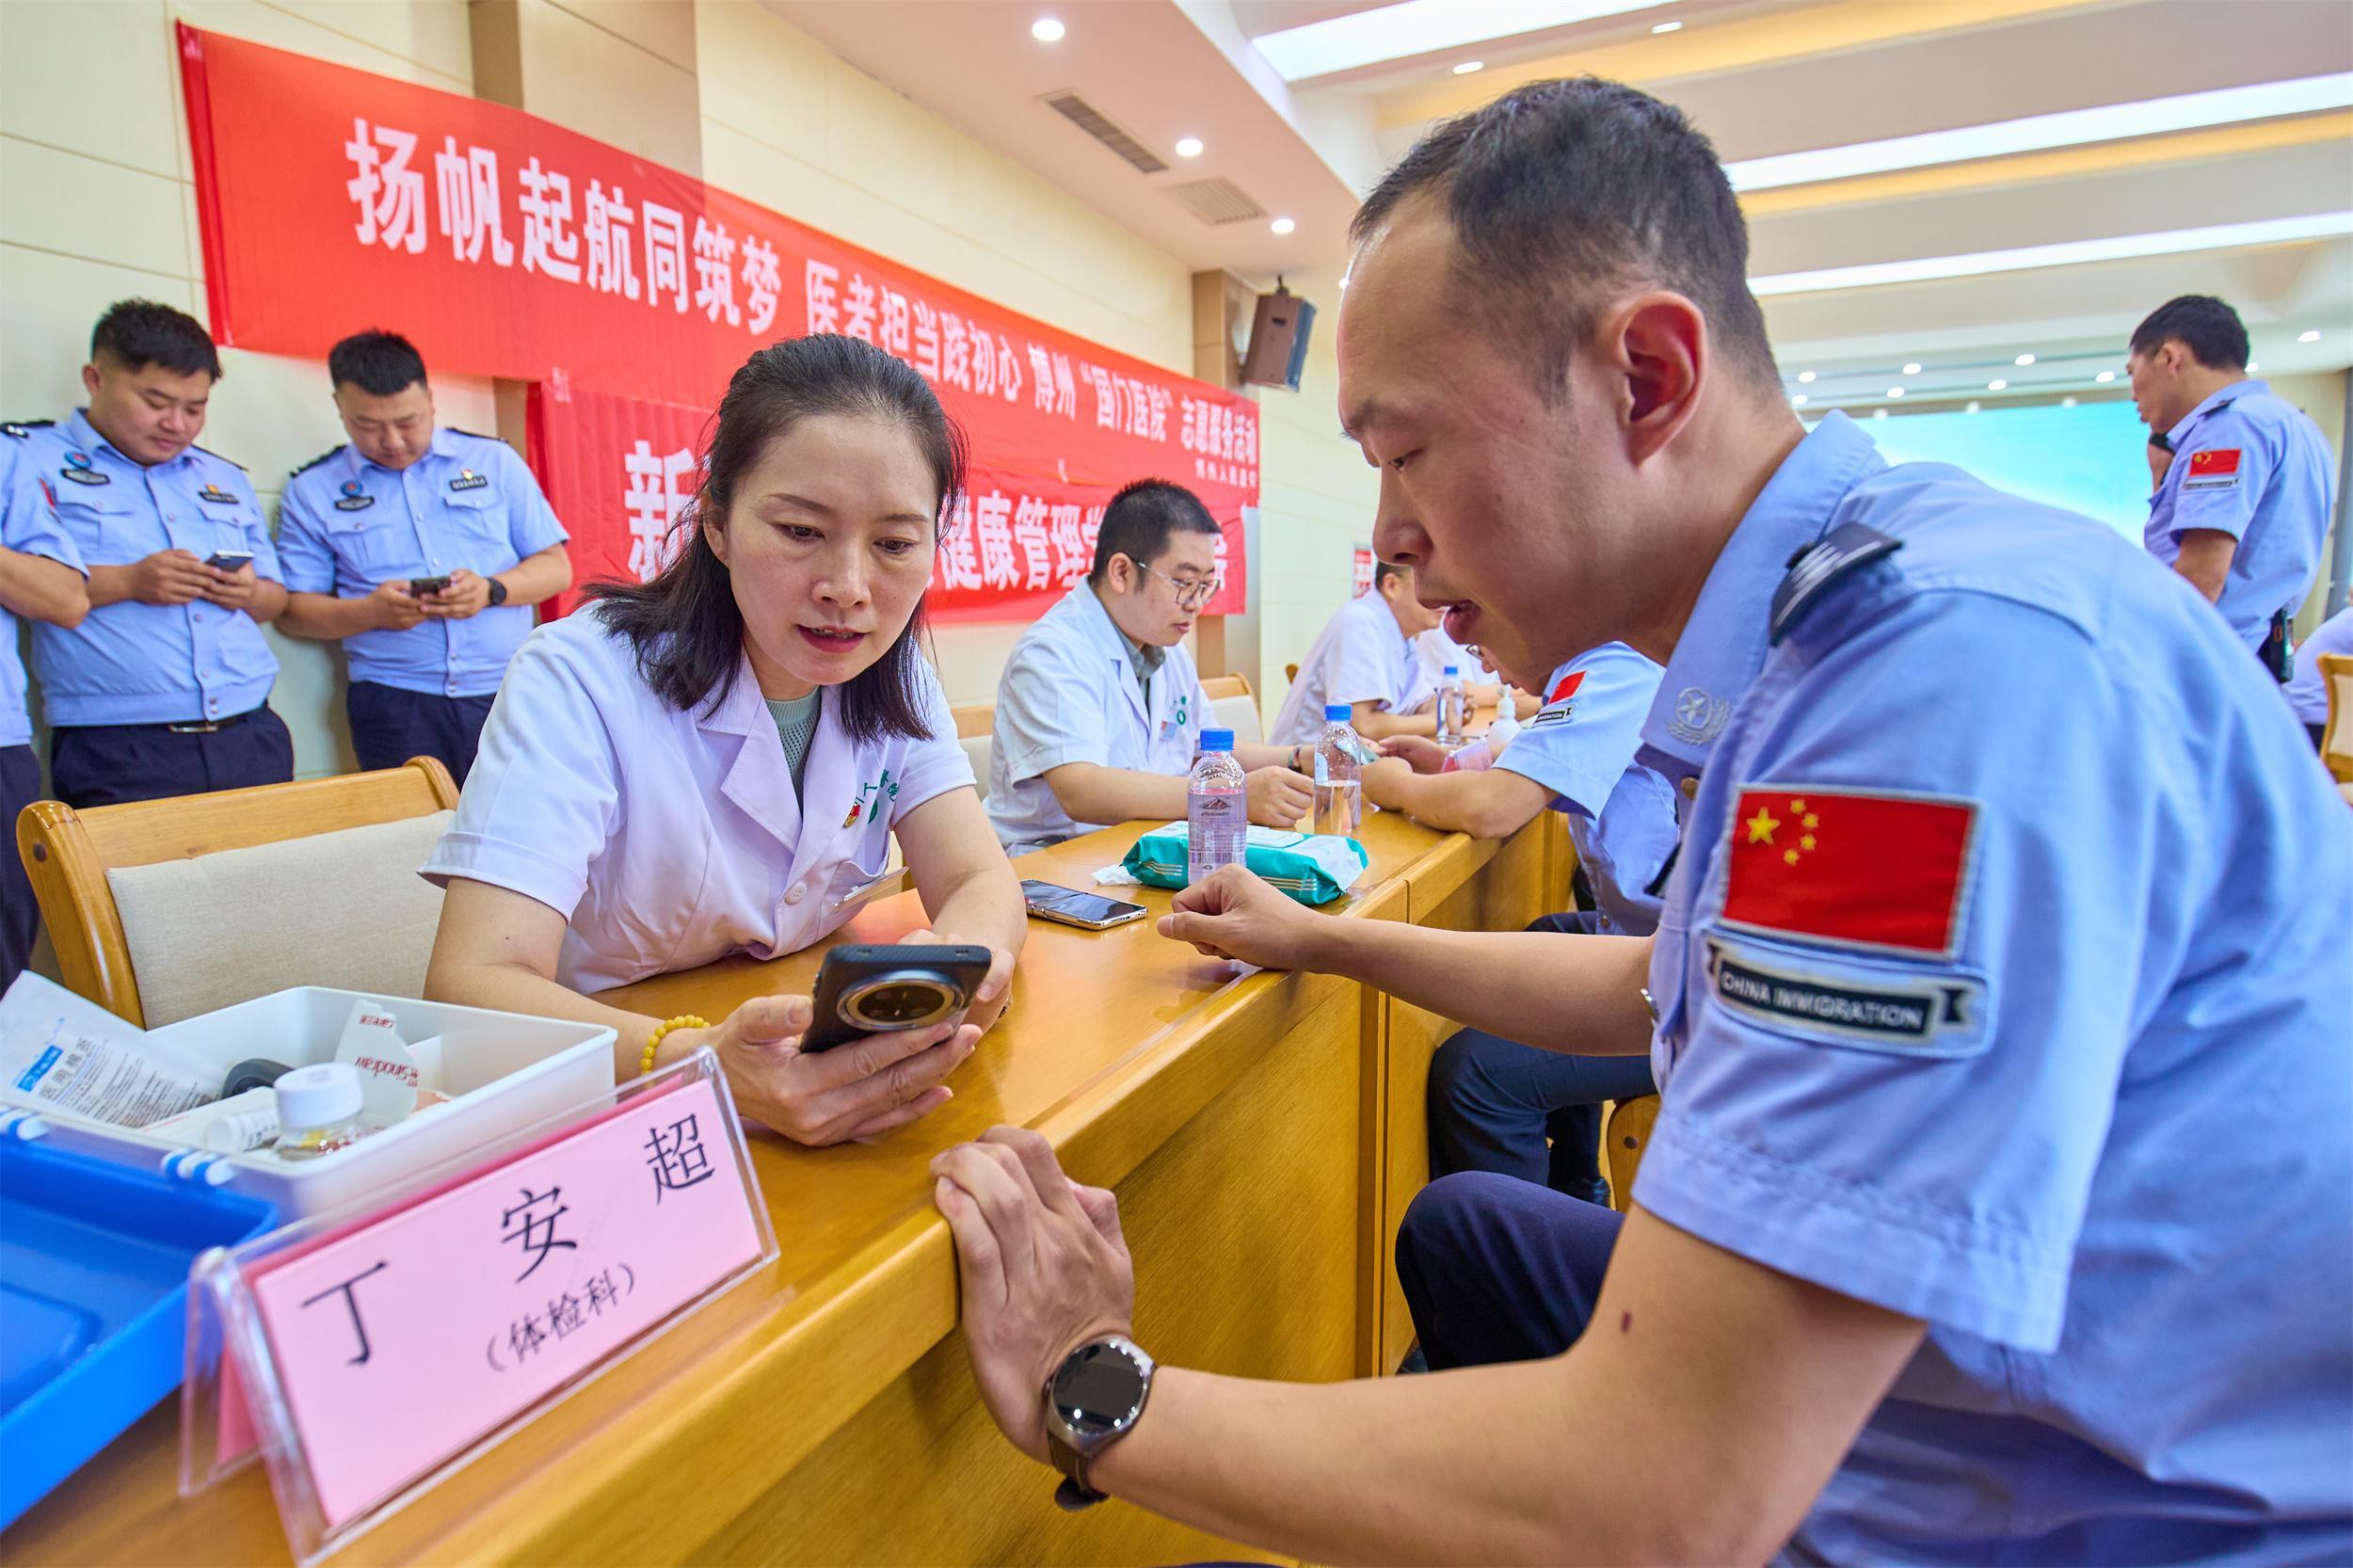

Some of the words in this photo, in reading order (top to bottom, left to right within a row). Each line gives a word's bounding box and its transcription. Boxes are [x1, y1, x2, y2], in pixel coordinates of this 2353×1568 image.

[344, 117, 781, 336] 扬帆起航同筑梦
[805, 258, 1022, 403] 医者担当践初心
[1721, 968, 1769, 1002] CHINA
